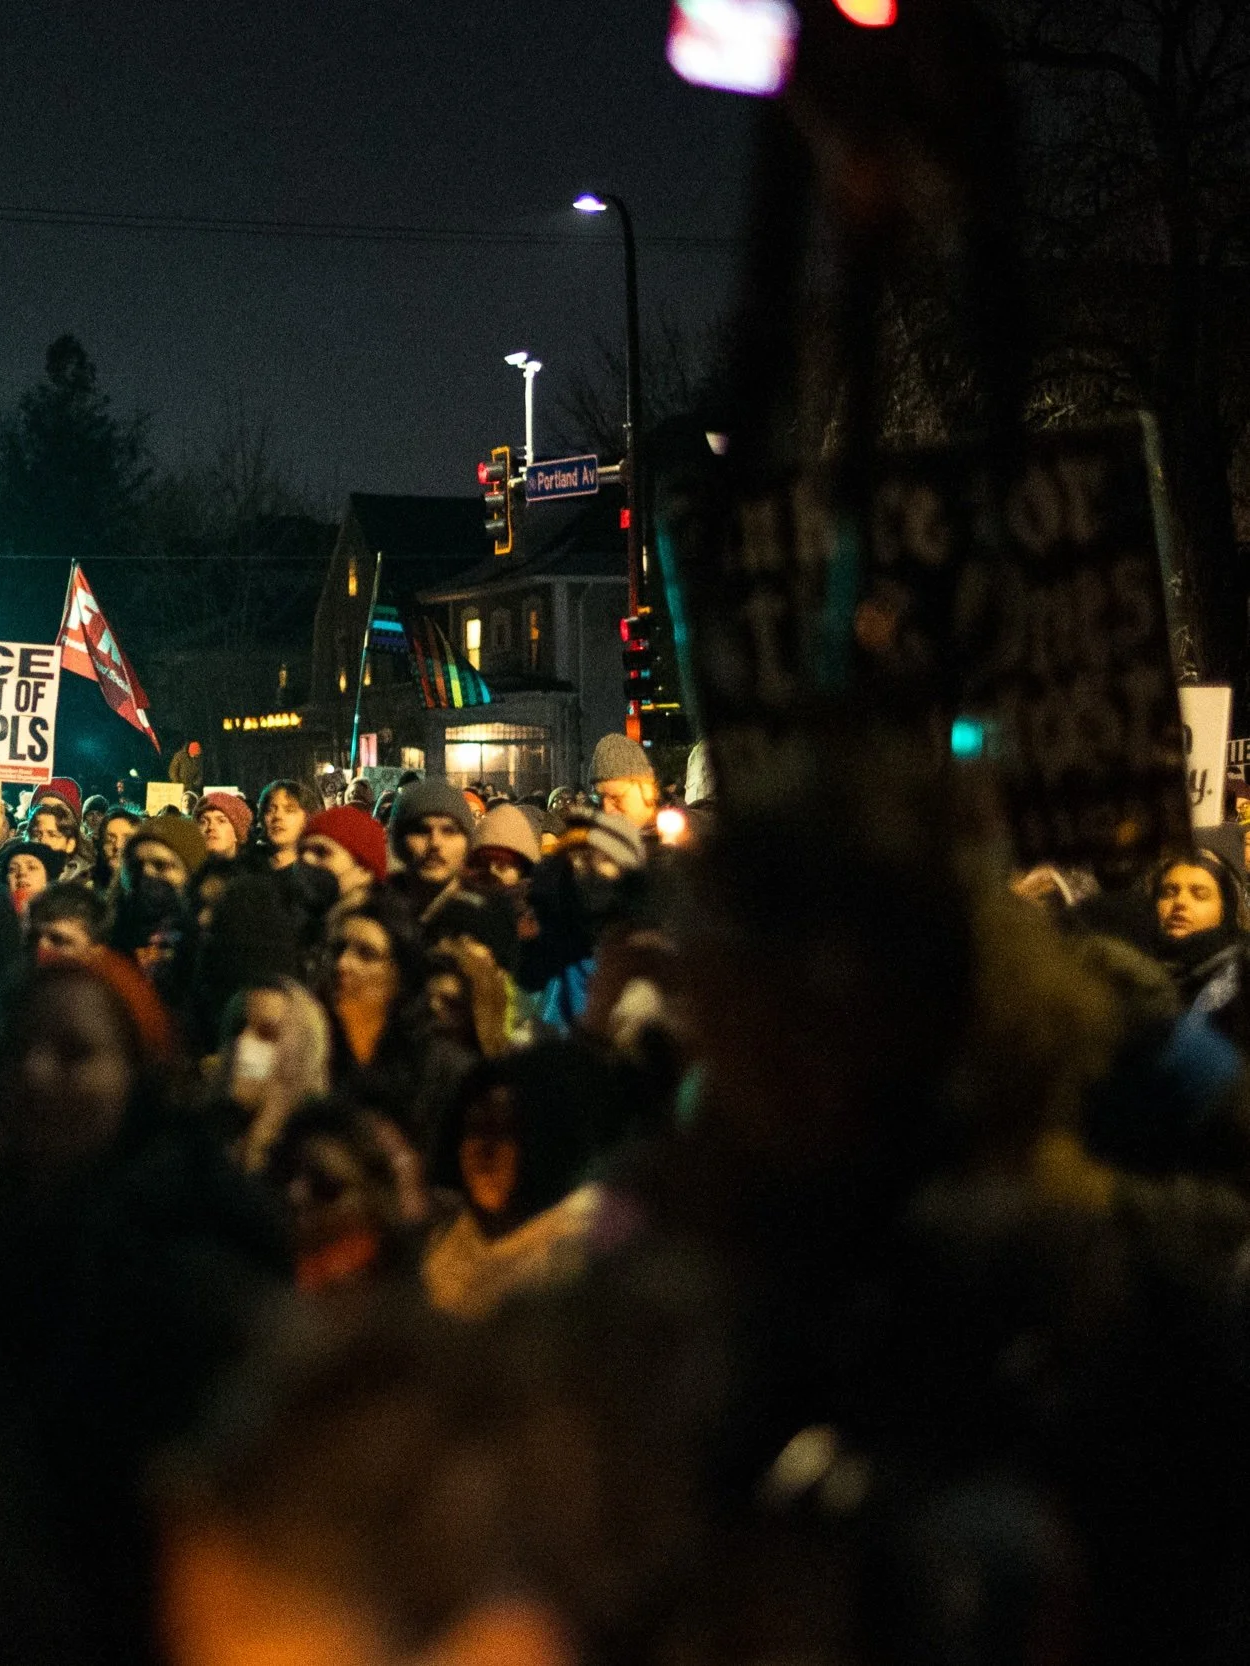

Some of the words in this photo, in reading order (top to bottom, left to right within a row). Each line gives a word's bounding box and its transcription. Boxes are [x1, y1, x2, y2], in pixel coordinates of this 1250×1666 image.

[537, 467, 578, 491] Portland
[582, 465, 595, 485] Av
[14, 680, 47, 713] OF
